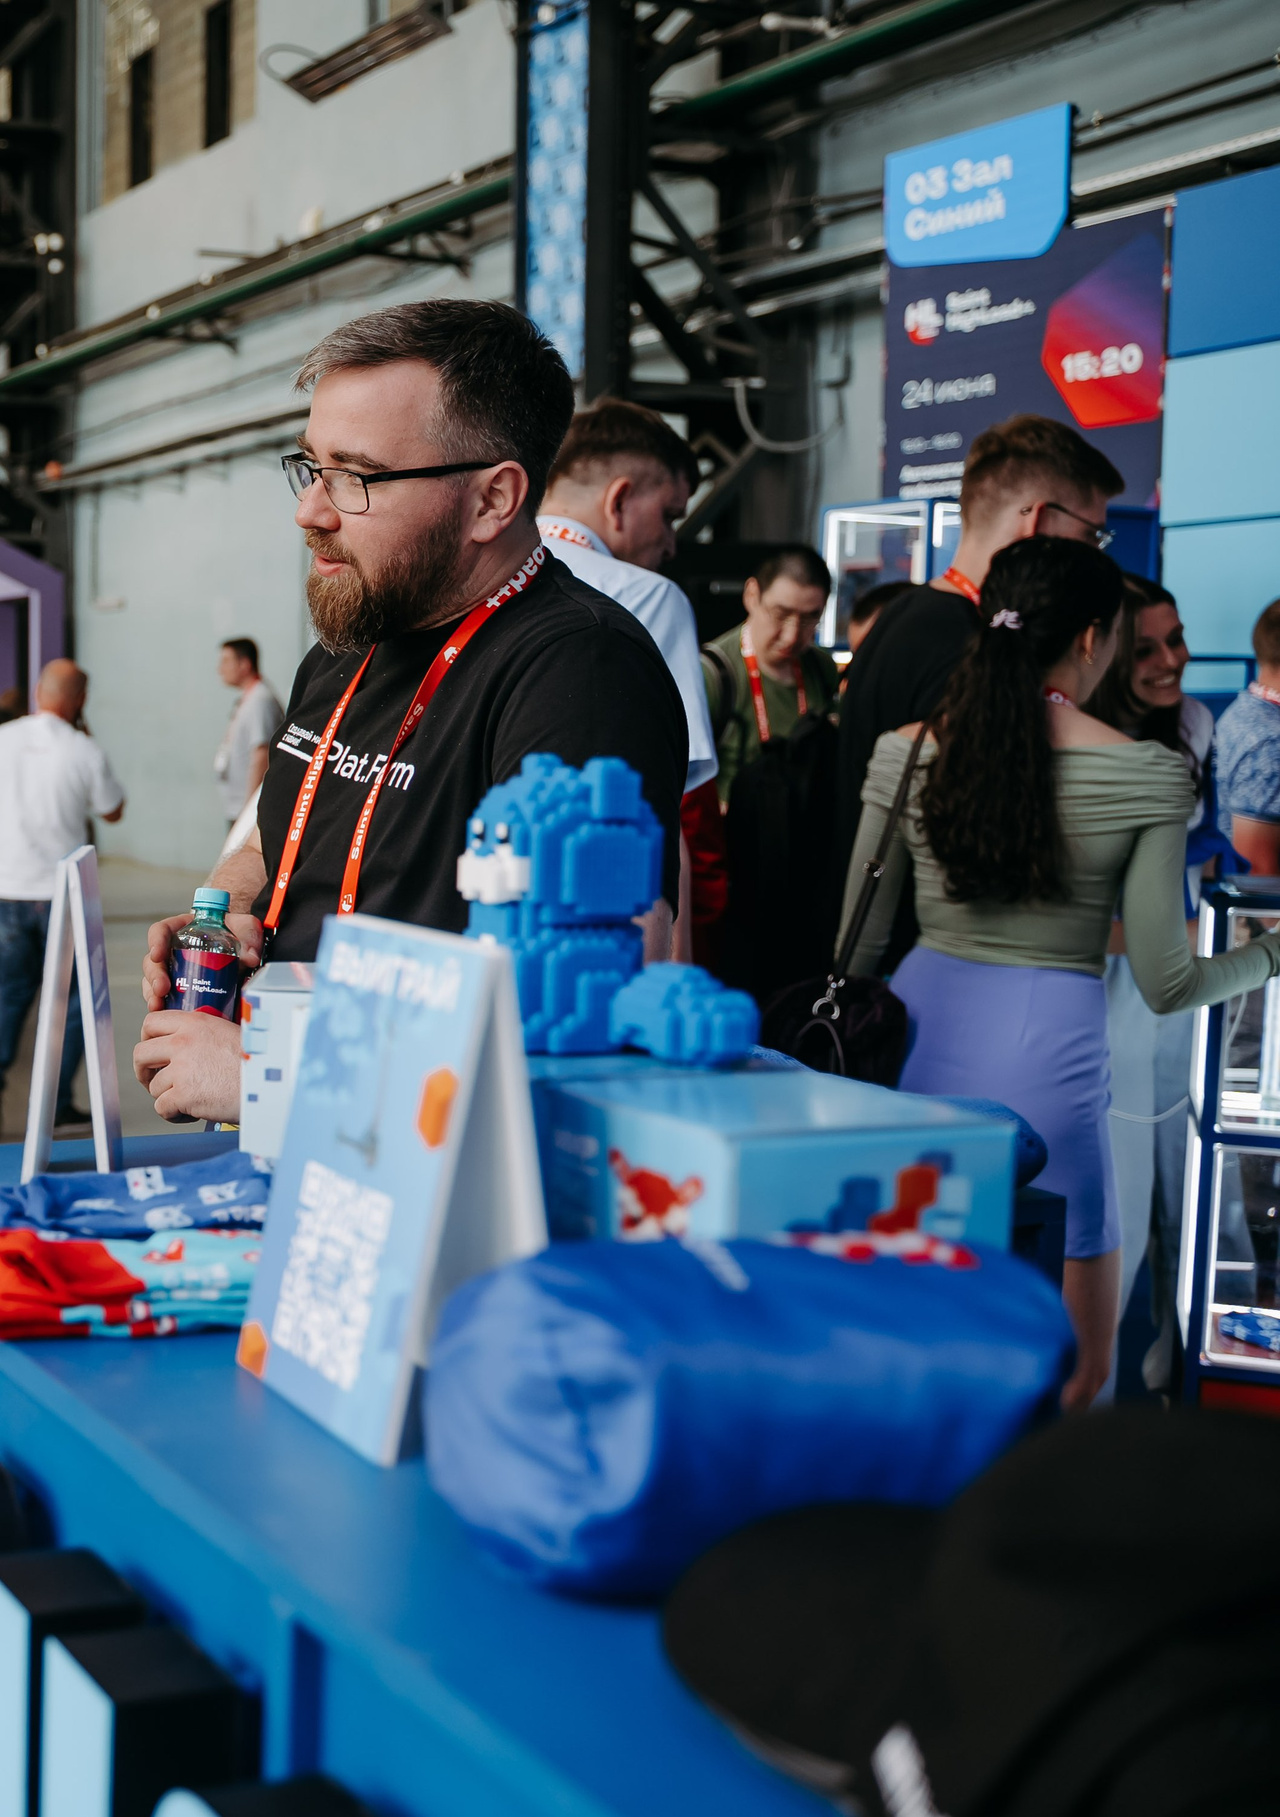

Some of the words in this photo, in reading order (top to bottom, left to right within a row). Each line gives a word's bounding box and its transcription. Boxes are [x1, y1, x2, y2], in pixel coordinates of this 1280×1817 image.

[904, 164, 949, 206] 03
[951, 154, 1014, 194] Зал
[903, 187, 1006, 242] Синий
[1060, 342, 1144, 383] 15:20
[901, 377, 934, 410] 24
[485, 540, 546, 609] oad++
[290, 792, 311, 842] Saint
[304, 693, 350, 790] HighLoad++
[350, 808, 371, 861] Saint
[192, 978, 212, 986] Saint
